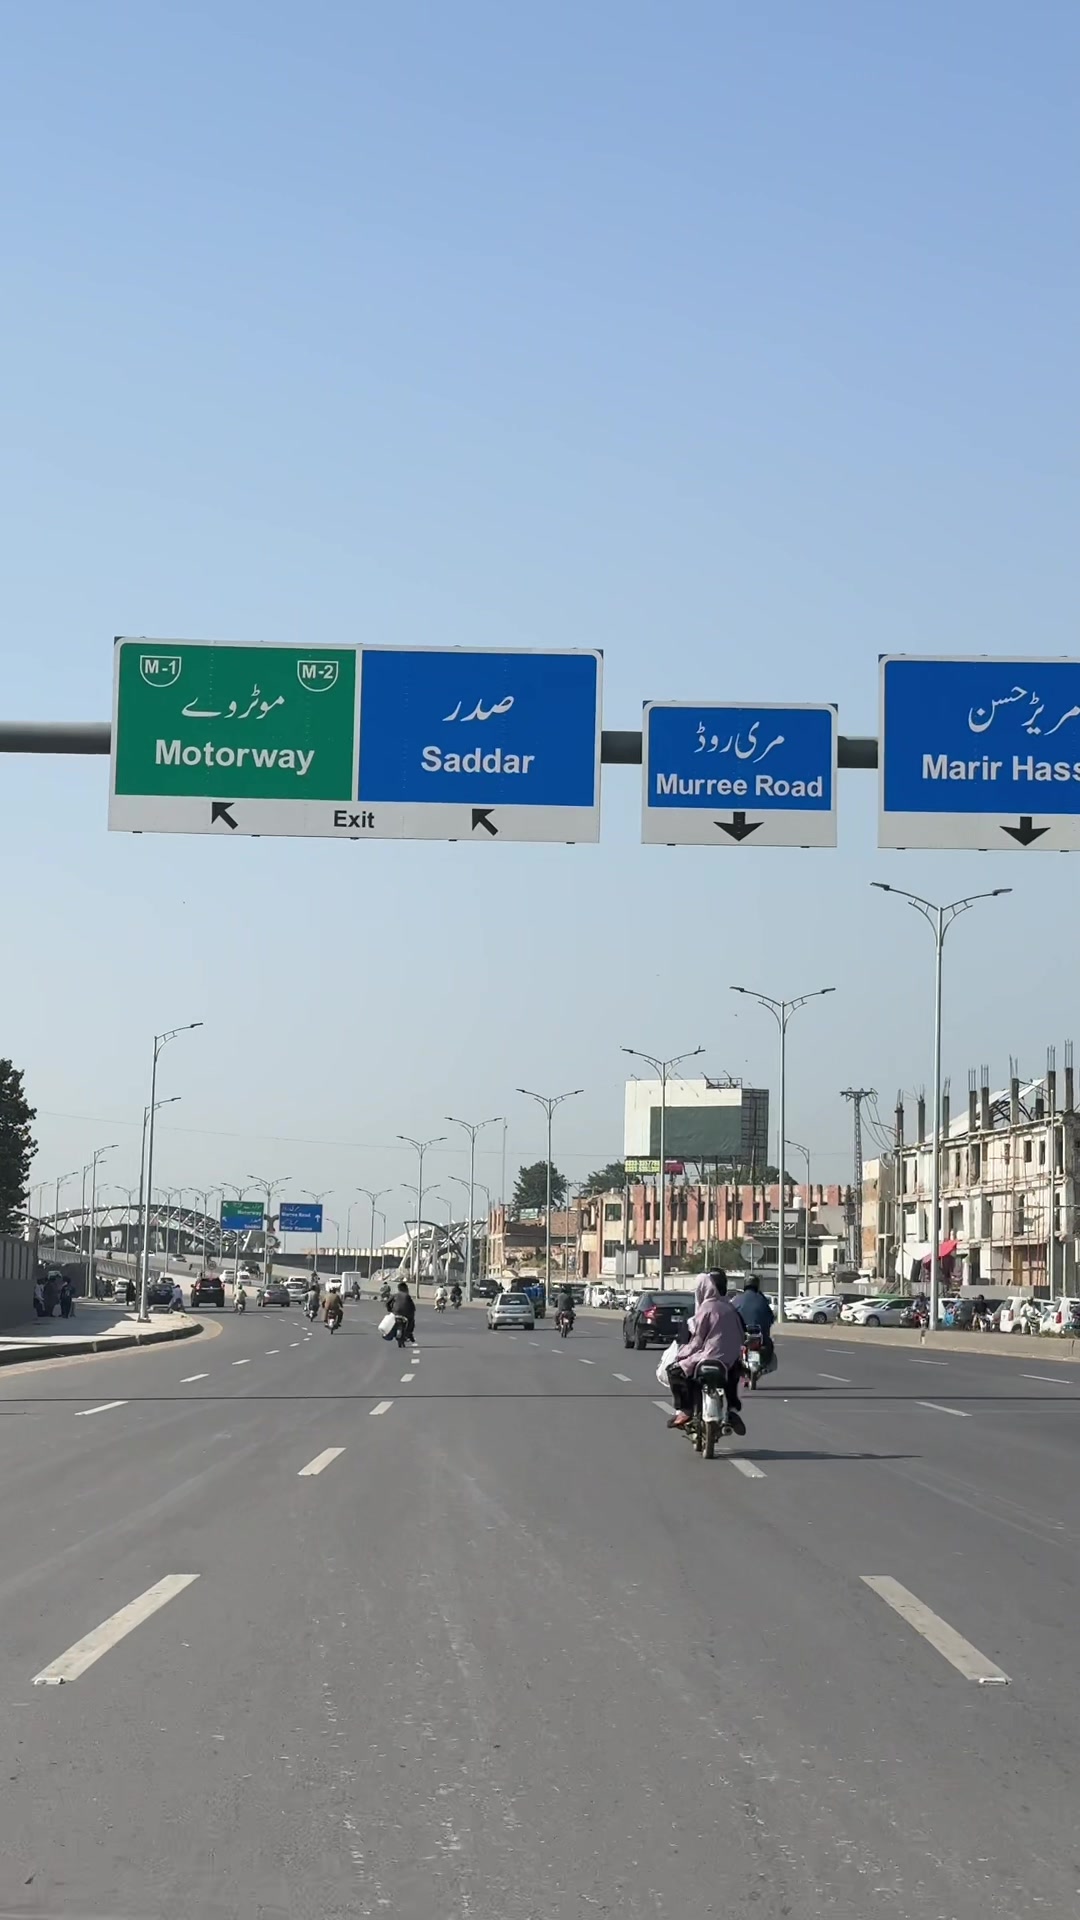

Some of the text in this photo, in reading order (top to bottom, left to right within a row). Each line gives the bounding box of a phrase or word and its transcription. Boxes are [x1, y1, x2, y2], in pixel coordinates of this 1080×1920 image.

[144, 659, 178, 675] M-1
[302, 664, 334, 680] M-2
[181, 684, 286, 720] موٹروے
[442, 694, 514, 722] صدر
[967, 685, 1028, 733] حسن
[693, 721, 786, 763] مری روڈ
[155, 738, 315, 777] Motorway
[420, 744, 536, 775] Saddar
[922, 753, 1003, 781] Marir
[656, 773, 823, 798] Murree Road
[333, 809, 375, 829] Exit
